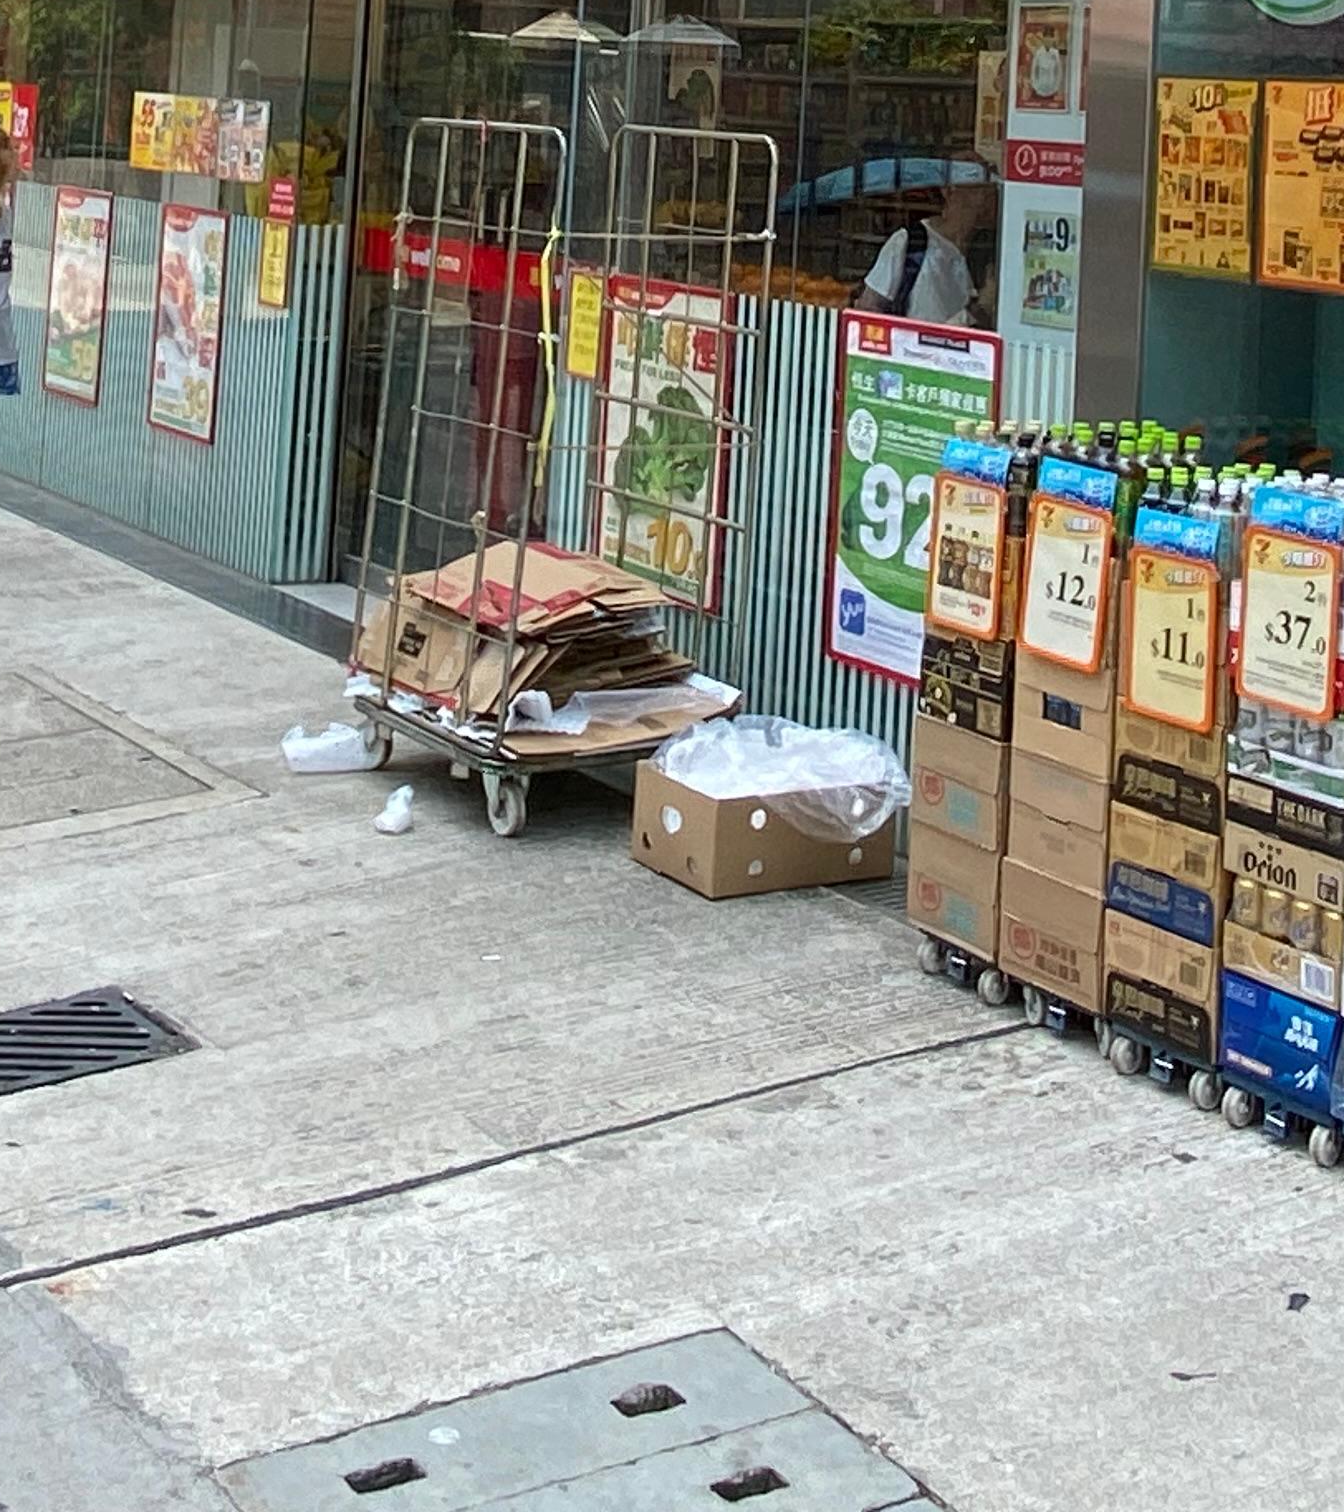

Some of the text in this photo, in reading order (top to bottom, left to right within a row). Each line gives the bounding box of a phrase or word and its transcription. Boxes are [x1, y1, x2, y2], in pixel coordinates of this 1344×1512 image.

[1045, 571, 1097, 612] $12.0
[1304, 580, 1316, 603] 2
[1151, 627, 1205, 669] $11.0
[1264, 610, 1327, 656] $37.0
